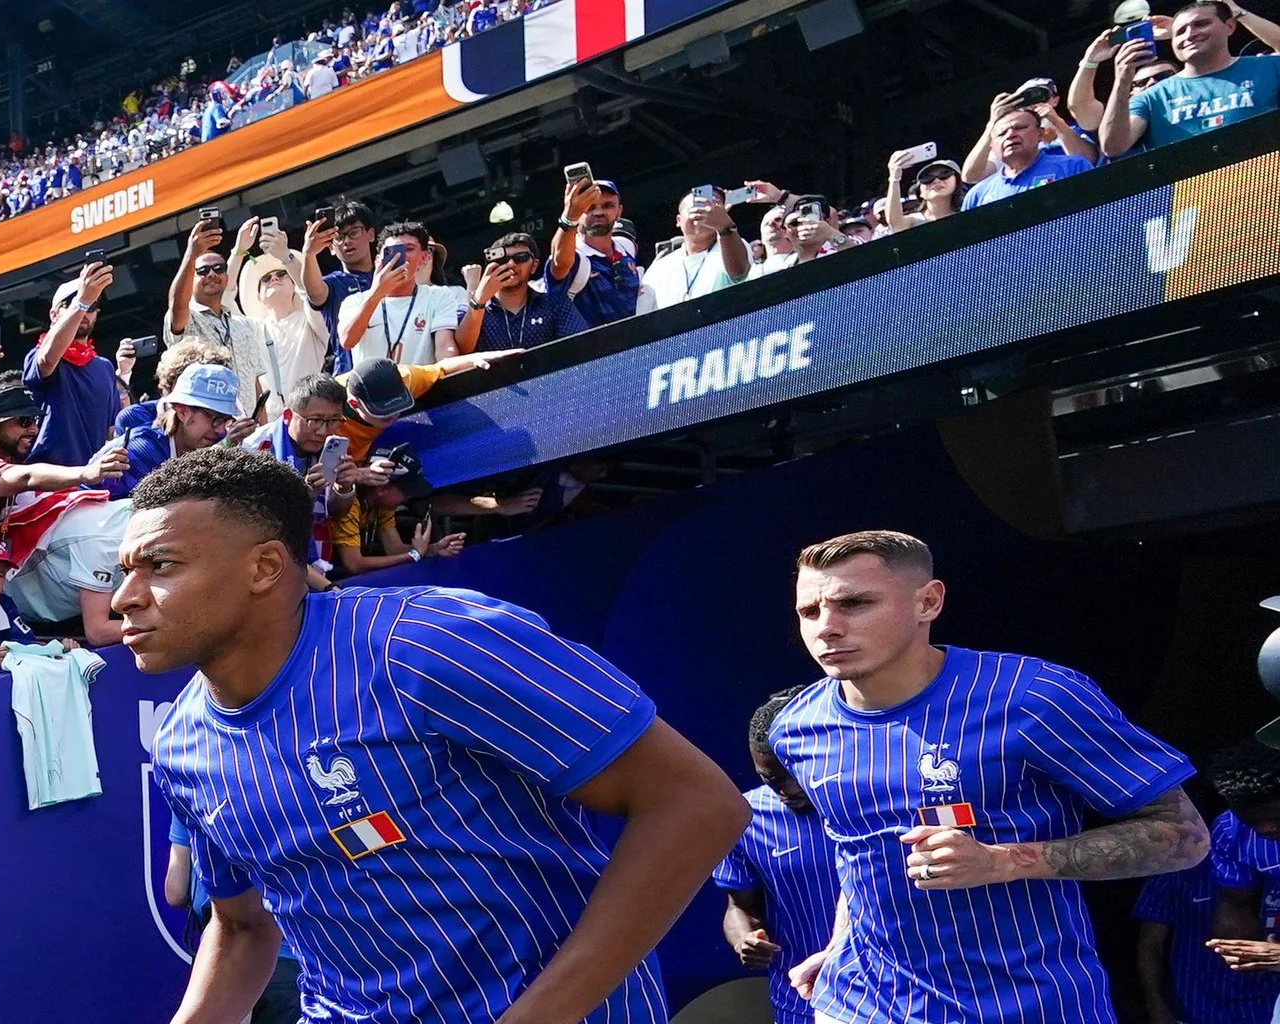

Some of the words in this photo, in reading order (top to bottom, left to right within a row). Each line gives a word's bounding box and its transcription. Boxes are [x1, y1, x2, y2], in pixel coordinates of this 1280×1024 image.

[1170, 91, 1254, 125] ITALIA
[71, 179, 154, 234] SWEDEN
[648, 321, 814, 410] FRANCE
